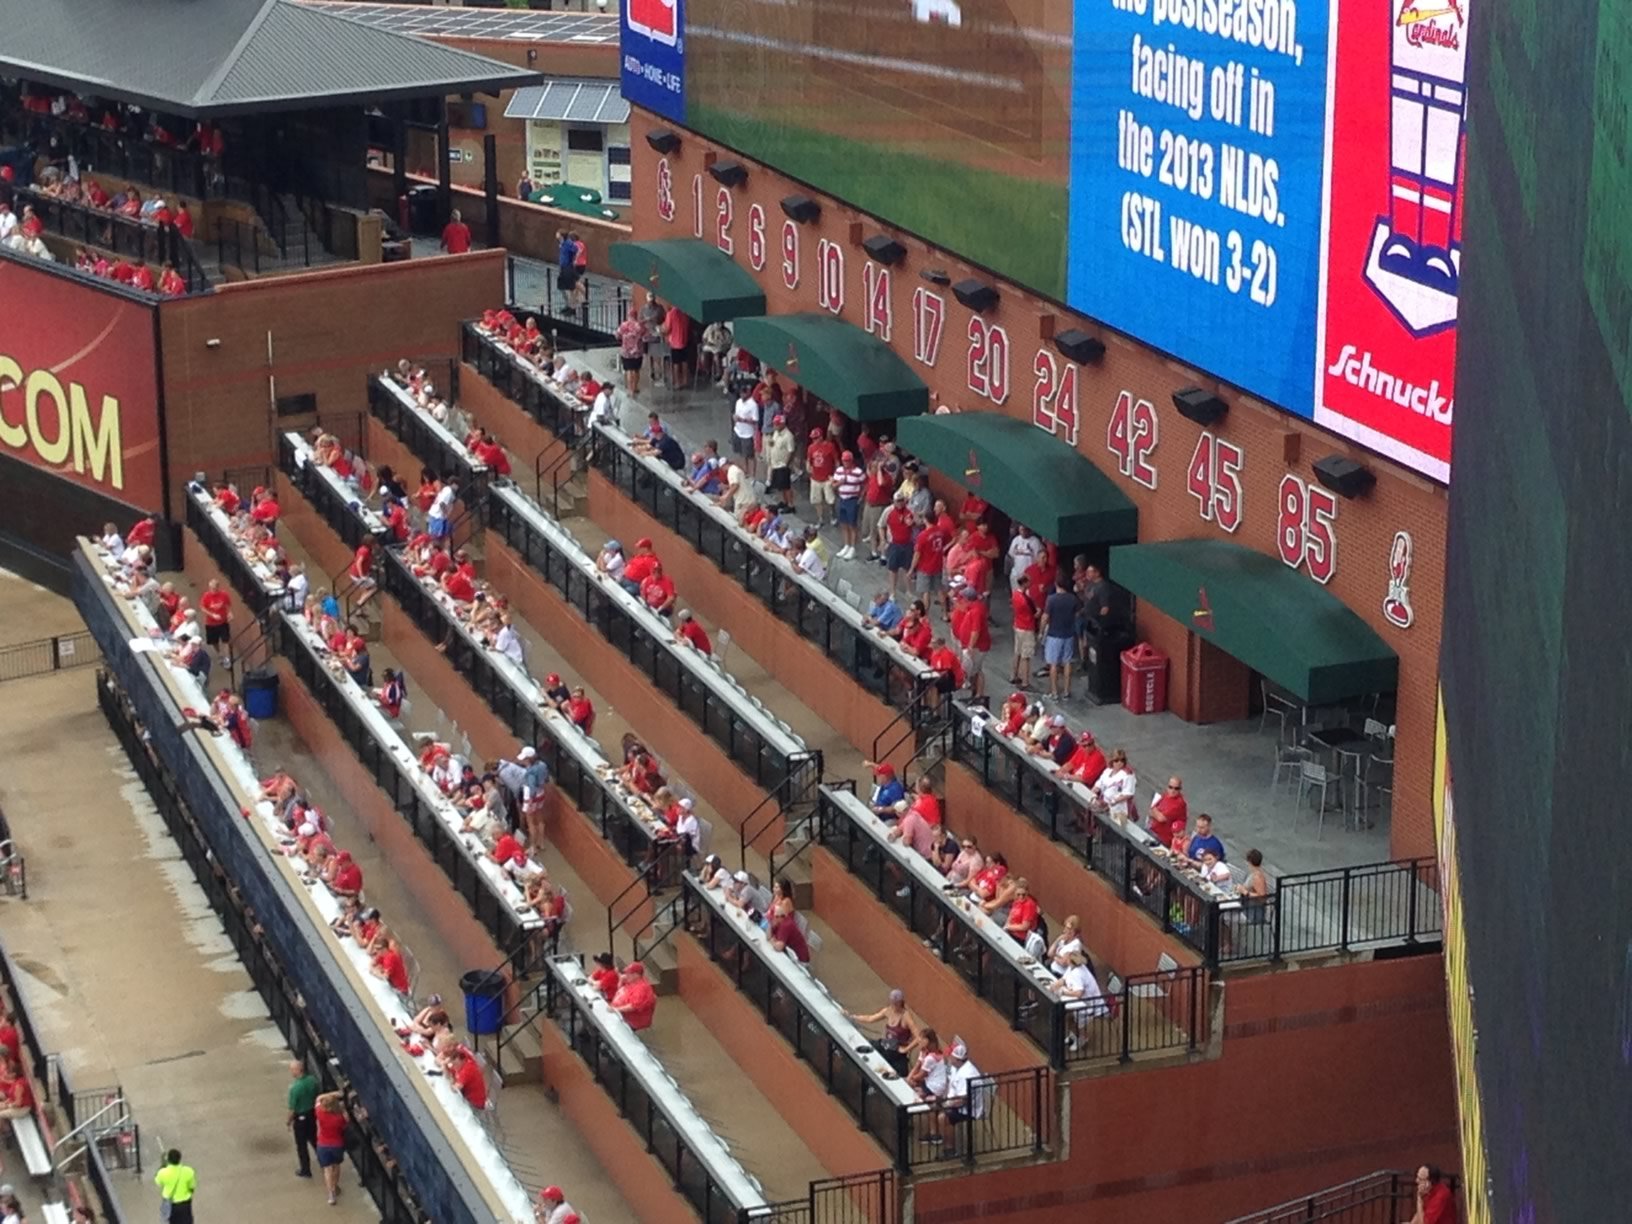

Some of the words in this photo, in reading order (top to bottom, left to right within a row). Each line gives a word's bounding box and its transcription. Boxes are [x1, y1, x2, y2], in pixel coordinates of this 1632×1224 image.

[665, 72, 681, 94] LIFE
[1132, 33, 1204, 120] facing
[1210, 60, 1244, 127] off
[1249, 67, 1275, 137] in
[1118, 109, 1154, 177] the
[1158, 129, 1214, 200] 2013
[1219, 143, 1286, 228] NLDS.
[717, 187, 734, 256] 2
[750, 203, 766, 272] 6
[782, 220, 799, 290] 9
[1121, 191, 1165, 263] (STL
[1169, 215, 1221, 286] won
[1226, 229, 1278, 308] 3-2)
[817, 238, 844, 315] 10
[863, 261, 891, 342] 14
[913, 287, 945, 366] 17
[967, 315, 1009, 405] 20
[1033, 348, 1080, 446] 24
[1107, 390, 1158, 490] 42
[1187, 431, 1244, 533] 45
[1277, 473, 1337, 585] 85
